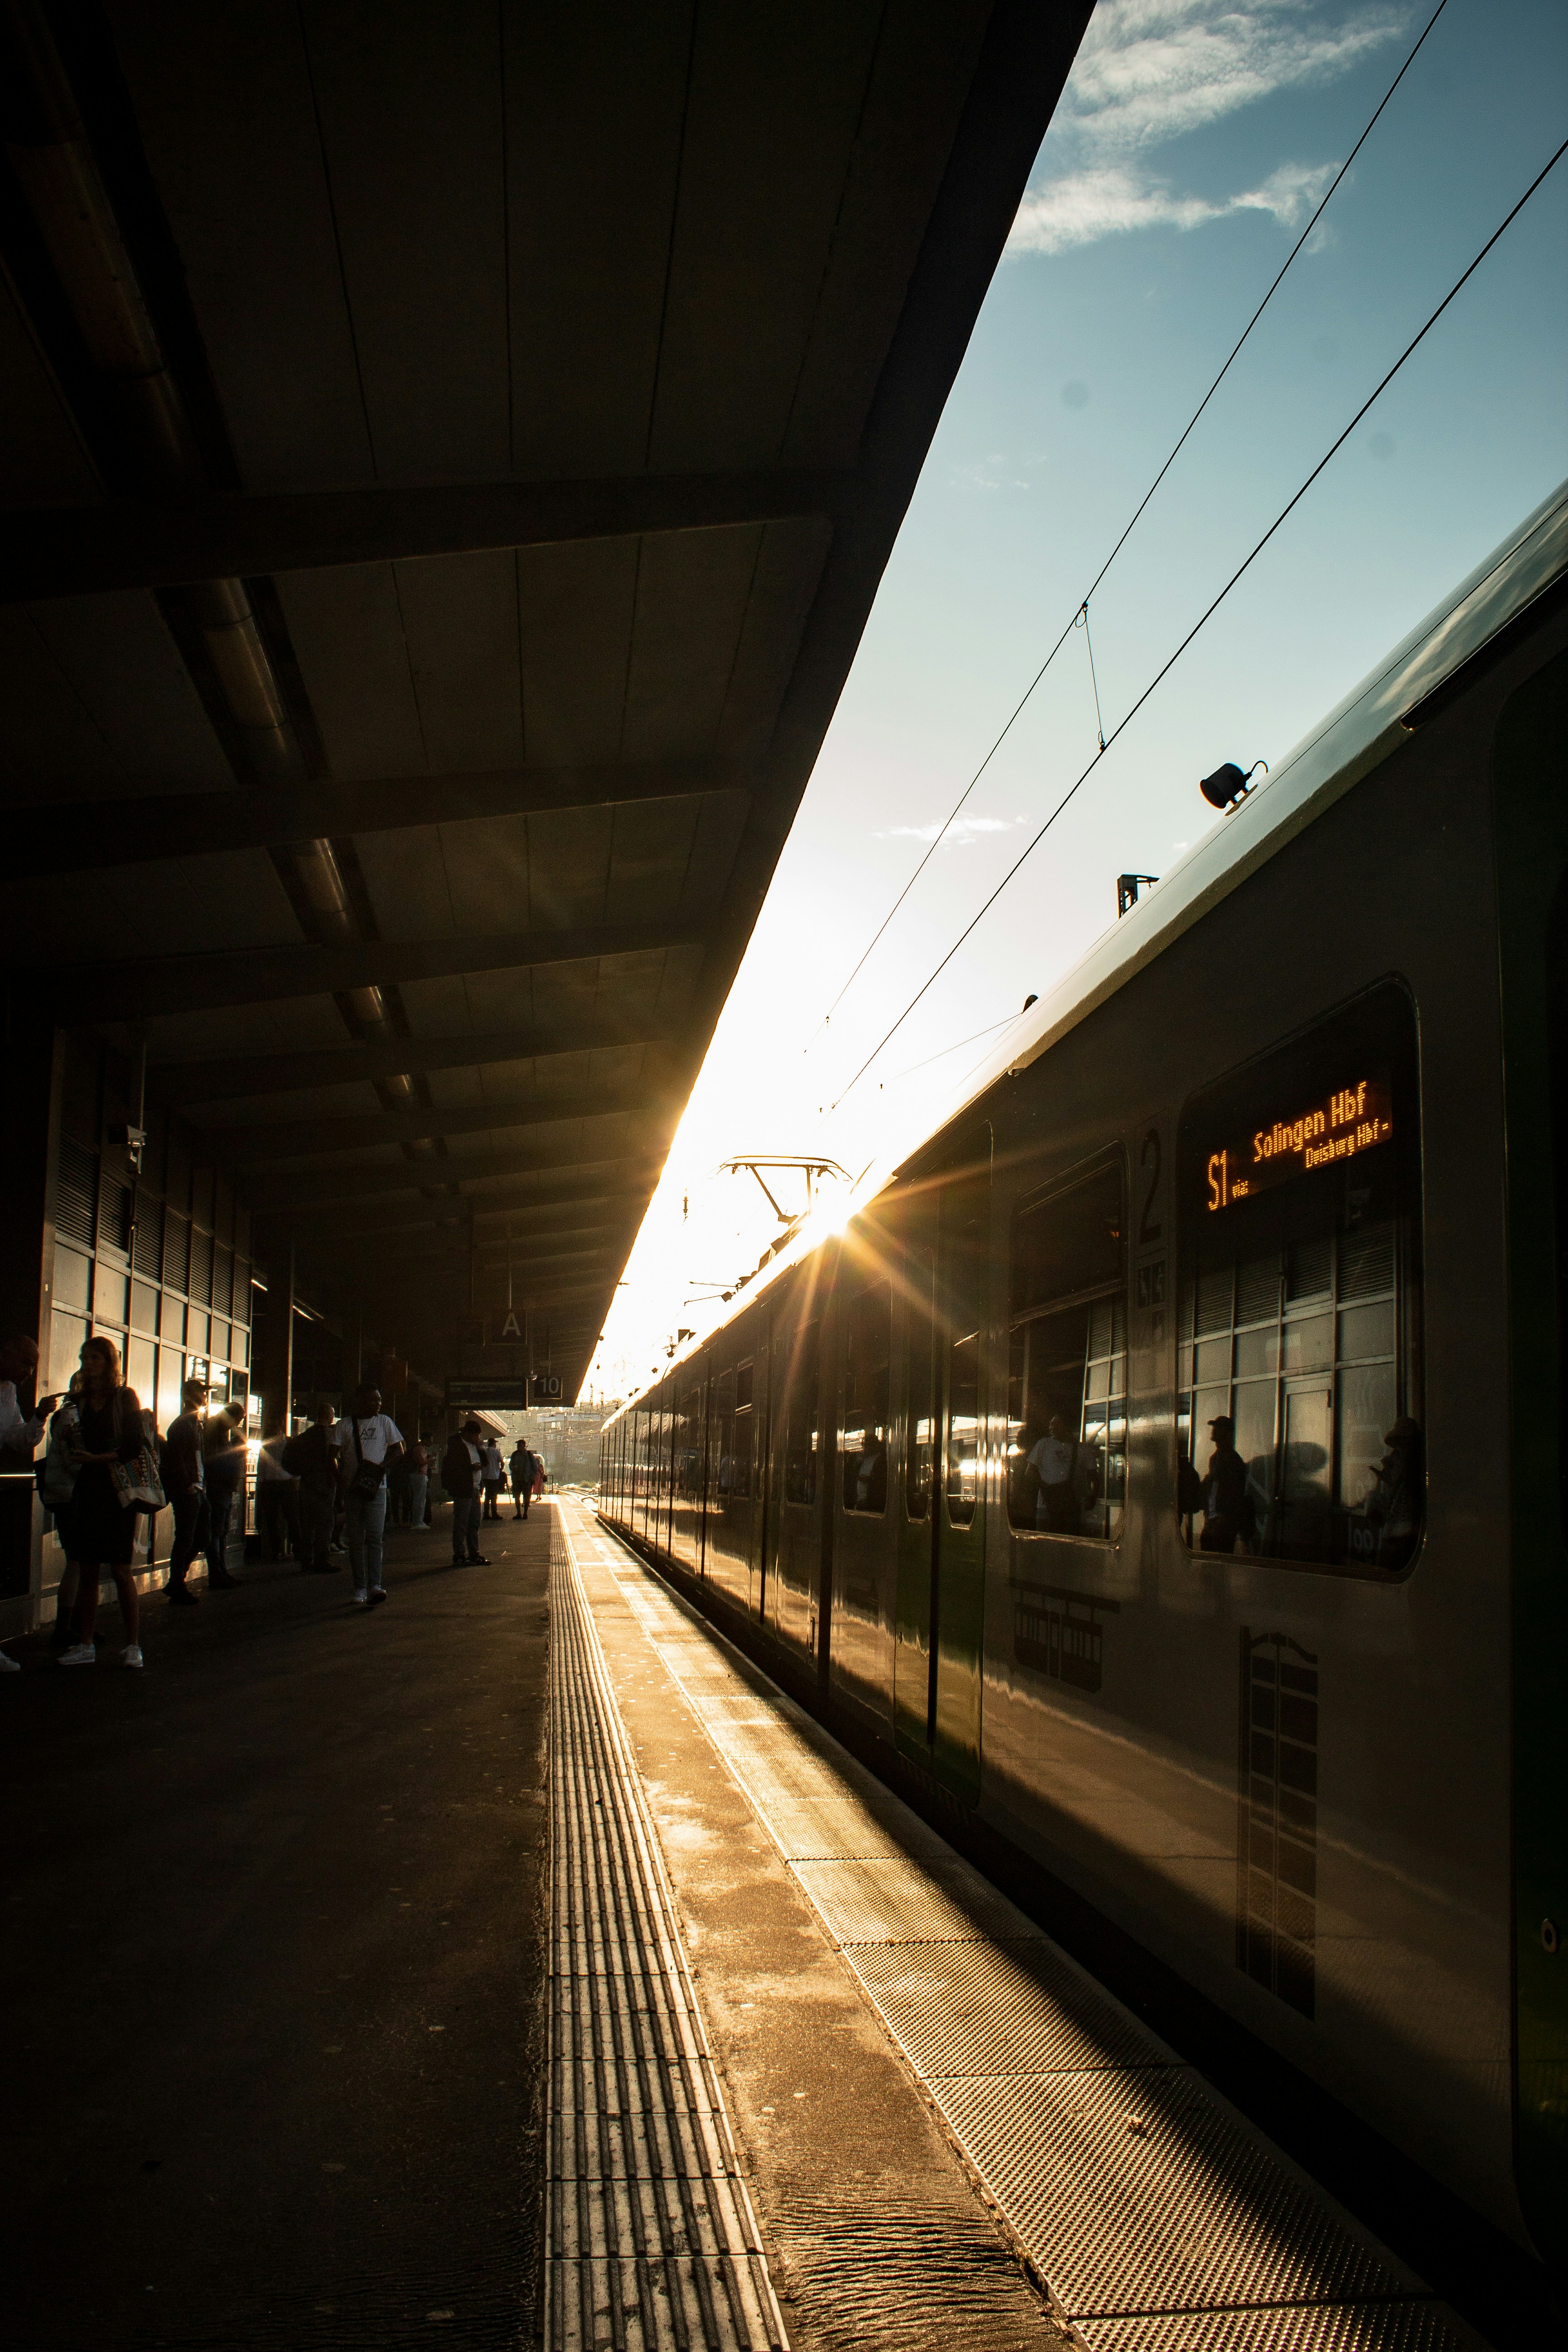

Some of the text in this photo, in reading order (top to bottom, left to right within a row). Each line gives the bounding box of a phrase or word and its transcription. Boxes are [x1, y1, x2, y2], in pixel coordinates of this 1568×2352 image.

[1254, 1081, 1367, 1163] Solingen Hbf
[1139, 1129, 1161, 1244] 2
[1208, 1150, 1226, 1210] S1
[1232, 1179, 1248, 1198] via
[1306, 1135, 1355, 1168] Duisburg
[1357, 1118, 1379, 1147] Hbf
[502, 1313, 521, 1336] A
[539, 1377, 559, 1394] 10
